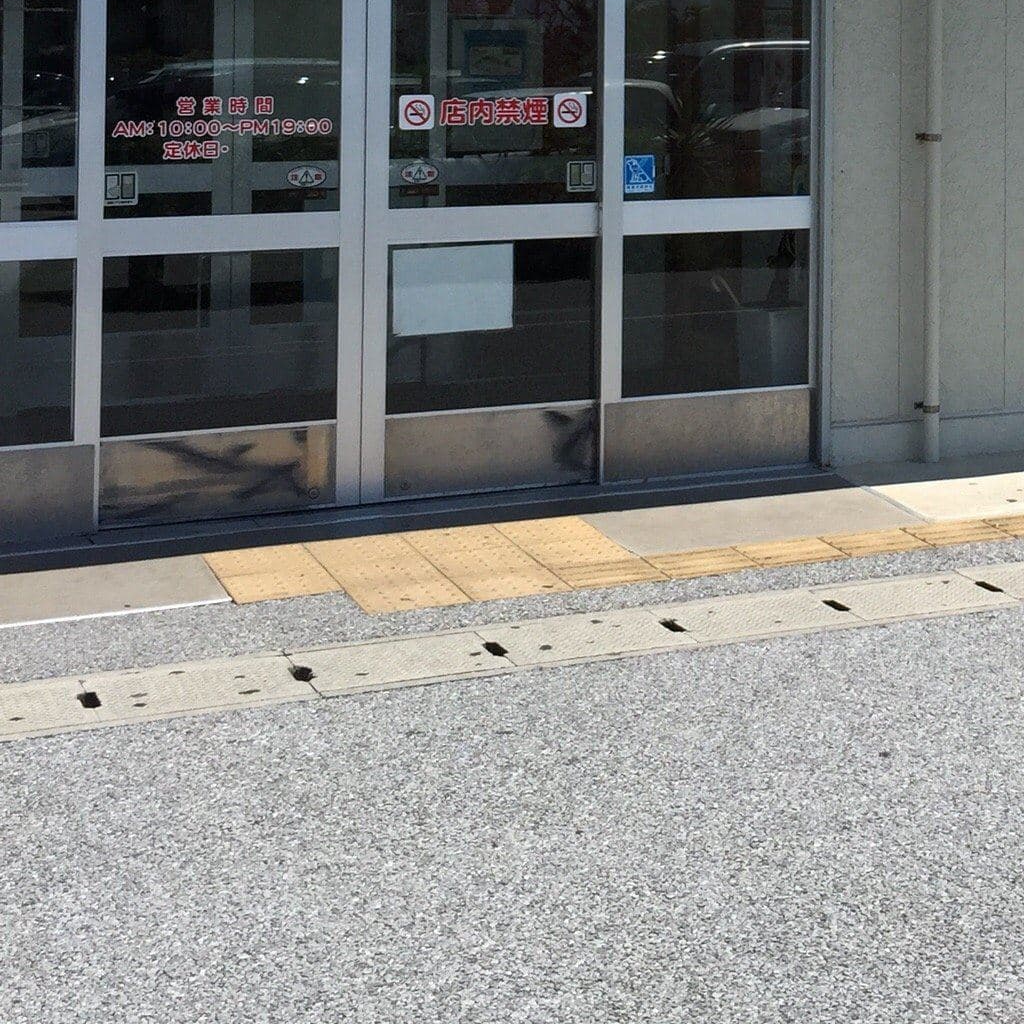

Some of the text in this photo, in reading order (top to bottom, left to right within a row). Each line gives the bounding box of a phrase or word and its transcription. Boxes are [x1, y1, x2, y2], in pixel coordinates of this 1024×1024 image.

[176, 96, 275, 115] 営業時間
[439, 97, 549, 126] 店内禁煙
